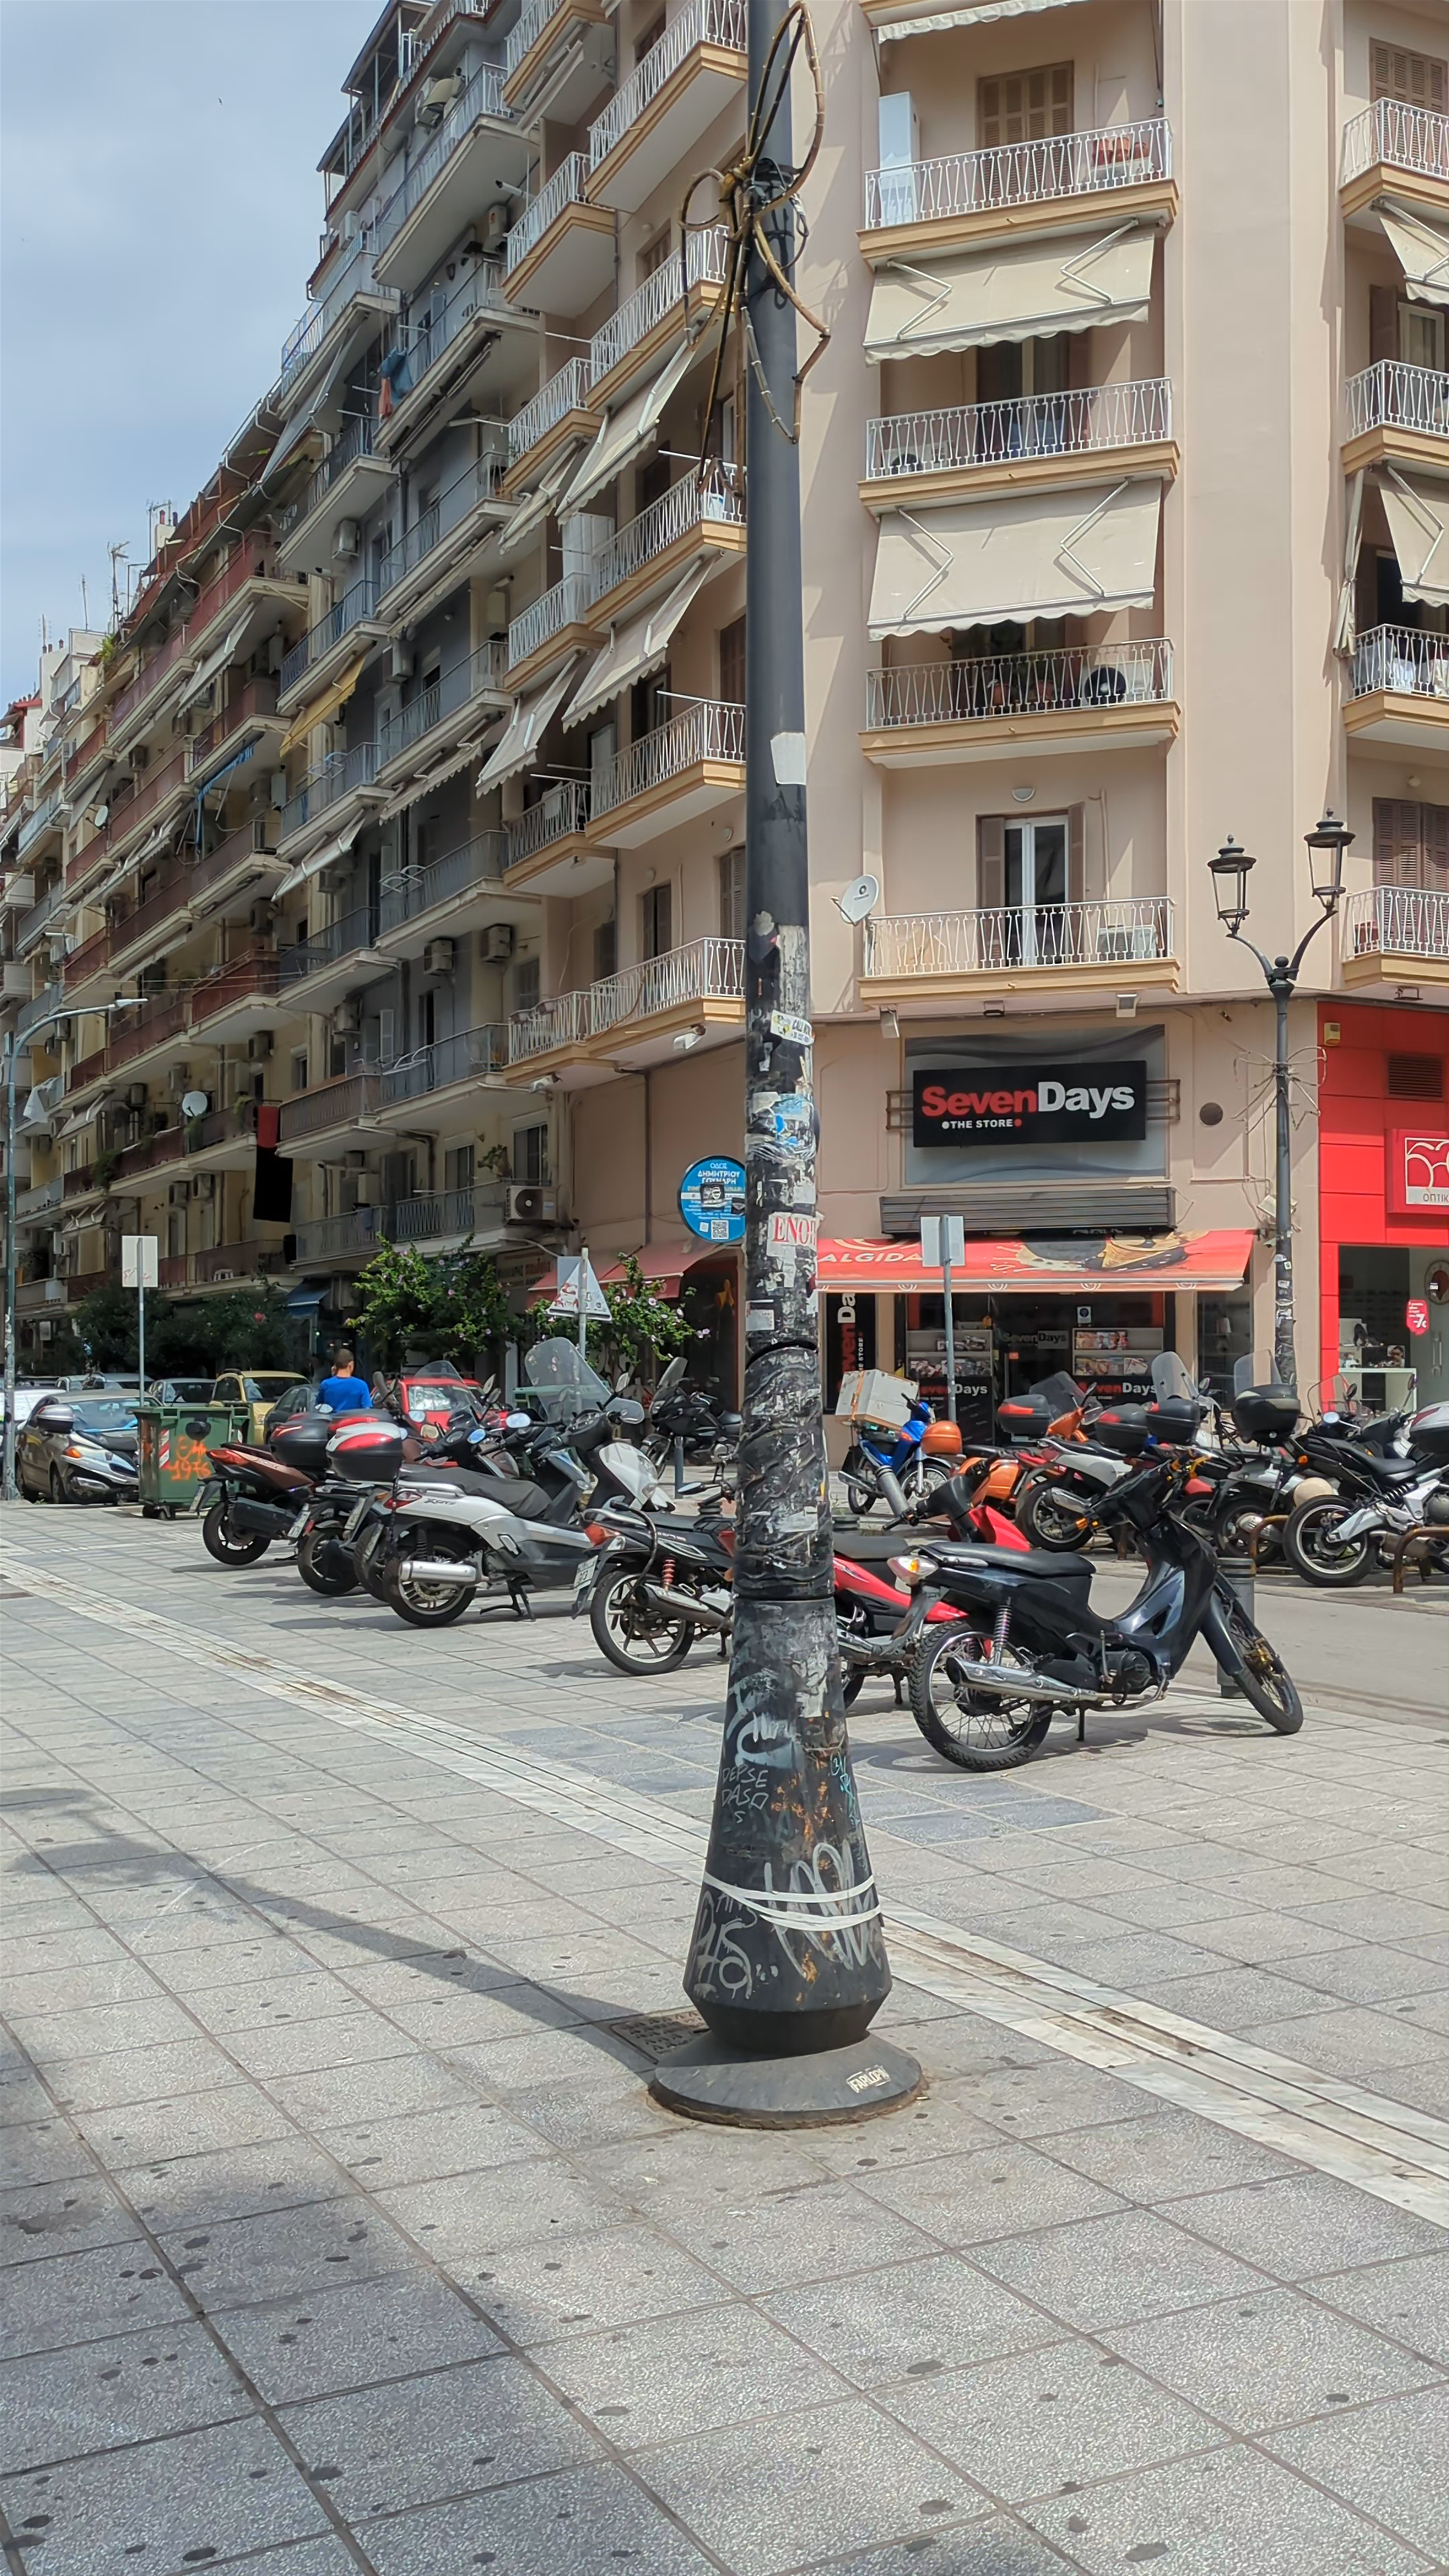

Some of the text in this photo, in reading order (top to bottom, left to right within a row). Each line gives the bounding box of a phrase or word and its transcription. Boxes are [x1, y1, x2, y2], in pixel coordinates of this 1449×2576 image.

[922, 1081, 1135, 1118] SevenDays
[950, 1119, 1013, 1129] THE STORE
[817, 1253, 923, 1262] ALGIDA
